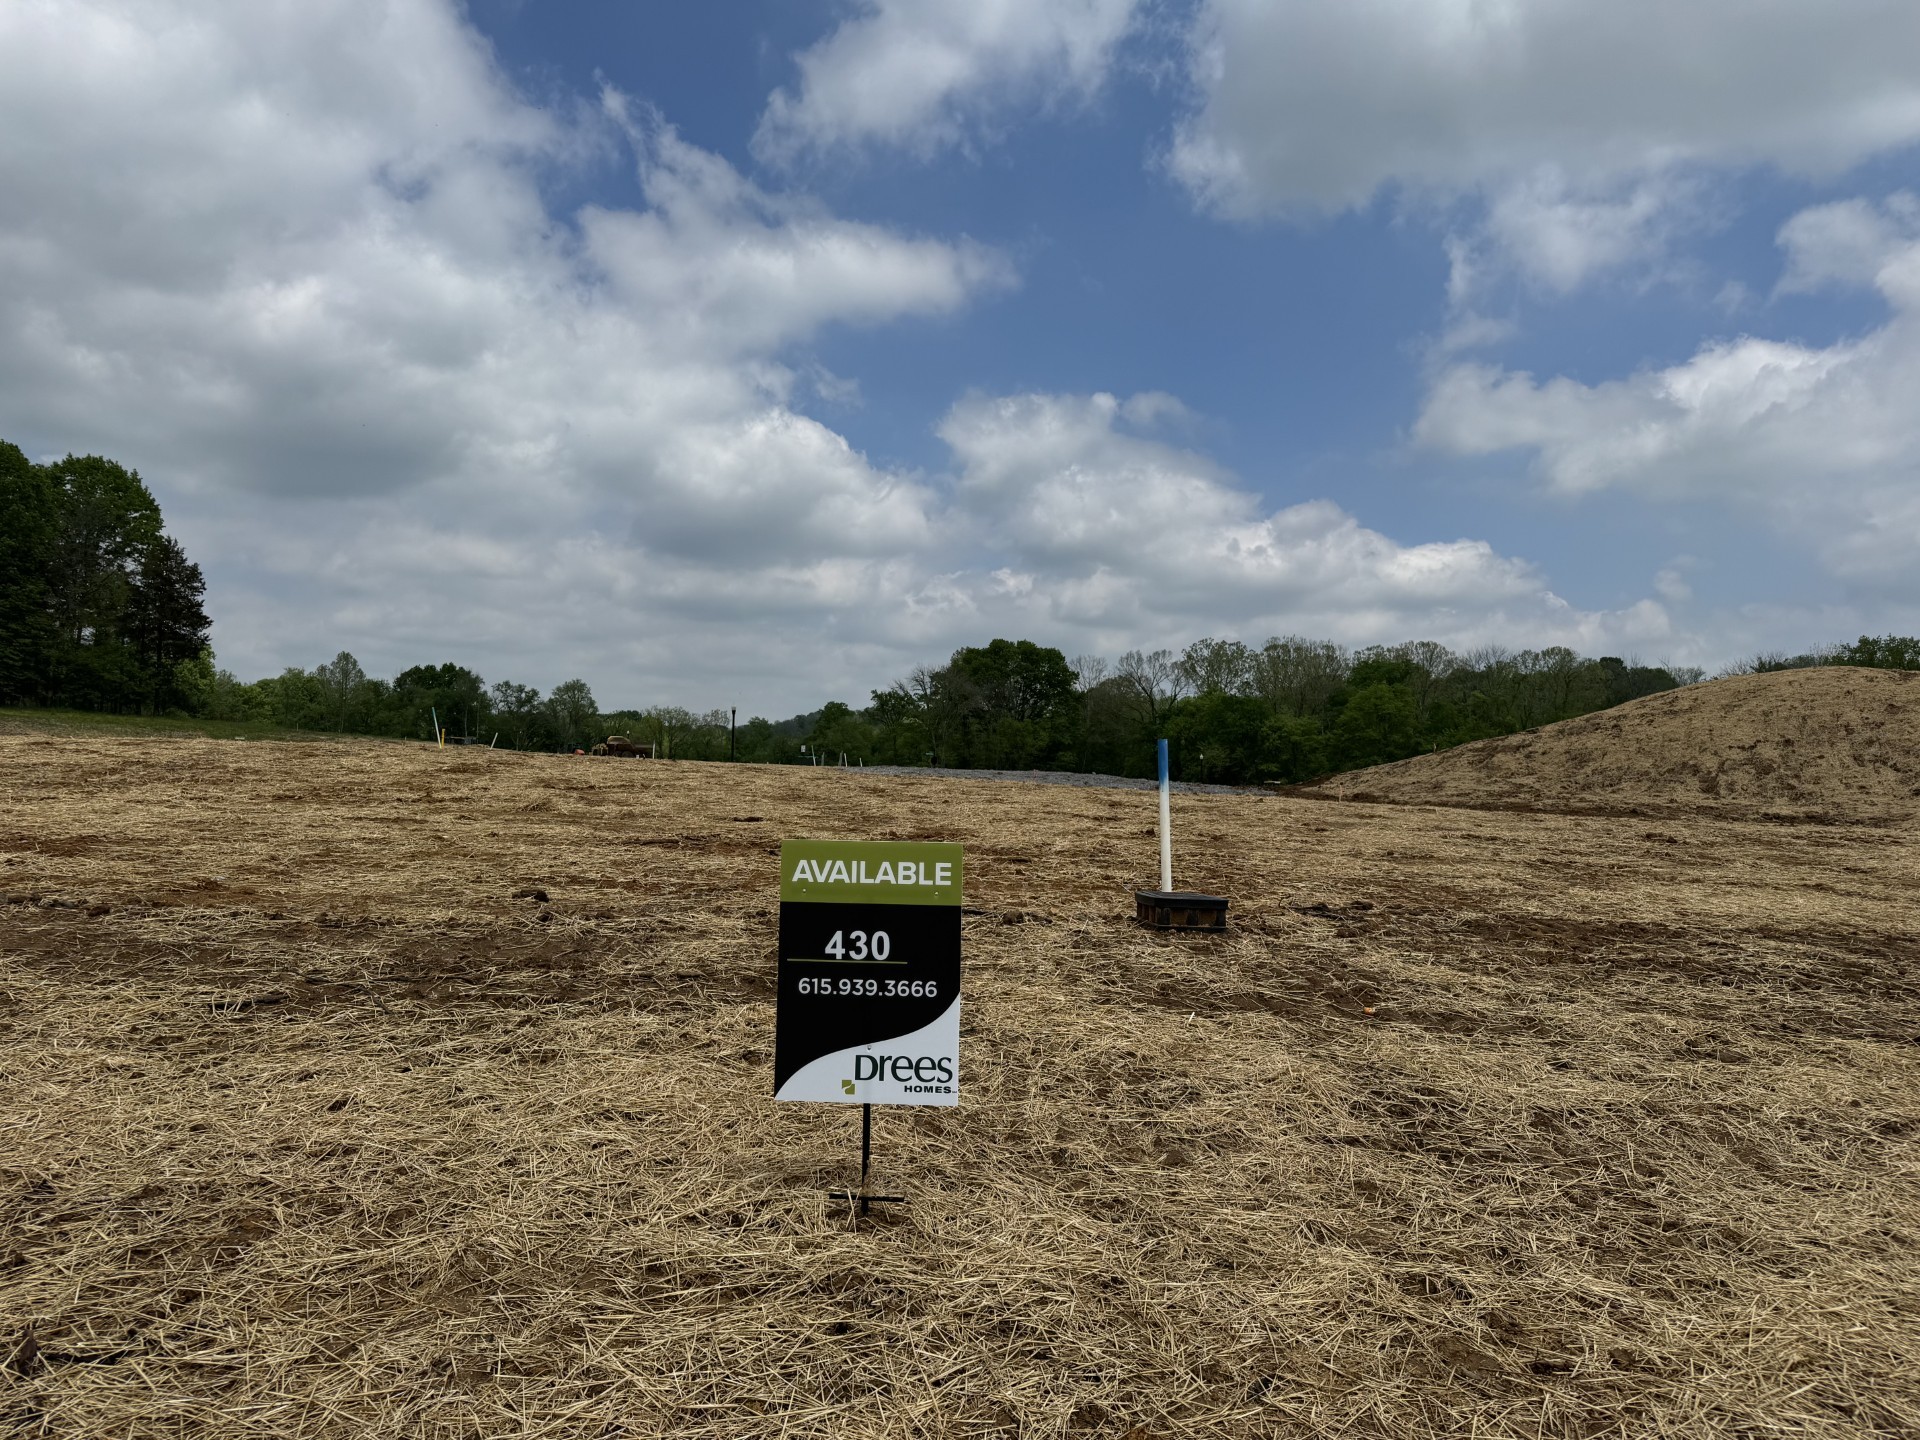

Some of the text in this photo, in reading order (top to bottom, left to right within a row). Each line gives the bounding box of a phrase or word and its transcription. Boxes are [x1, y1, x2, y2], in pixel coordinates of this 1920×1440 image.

[791, 859, 952, 886] AVAILABLE
[824, 930, 890, 961] 430
[798, 977, 937, 998] 615.939.3666
[854, 1054, 953, 1083] Drees
[904, 1085, 952, 1094] HOMES
